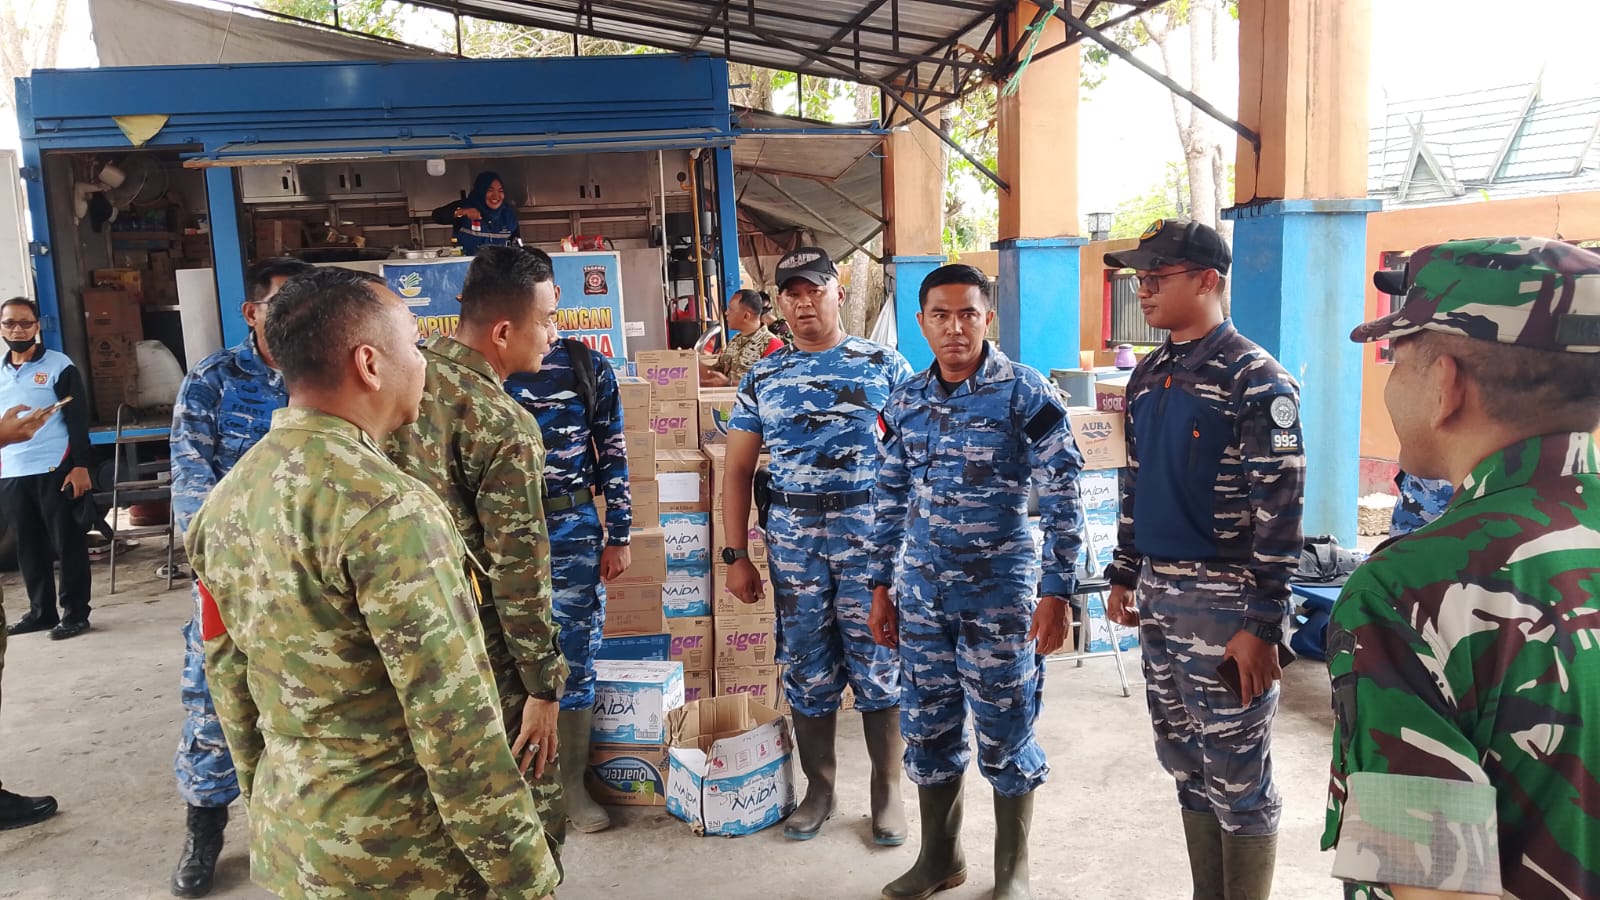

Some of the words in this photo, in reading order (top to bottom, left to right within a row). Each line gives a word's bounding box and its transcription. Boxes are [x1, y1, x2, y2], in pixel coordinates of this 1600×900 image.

[1081, 421, 1112, 431] AURA
[1274, 434, 1298, 447] 992
[605, 767, 648, 784] Quarter
